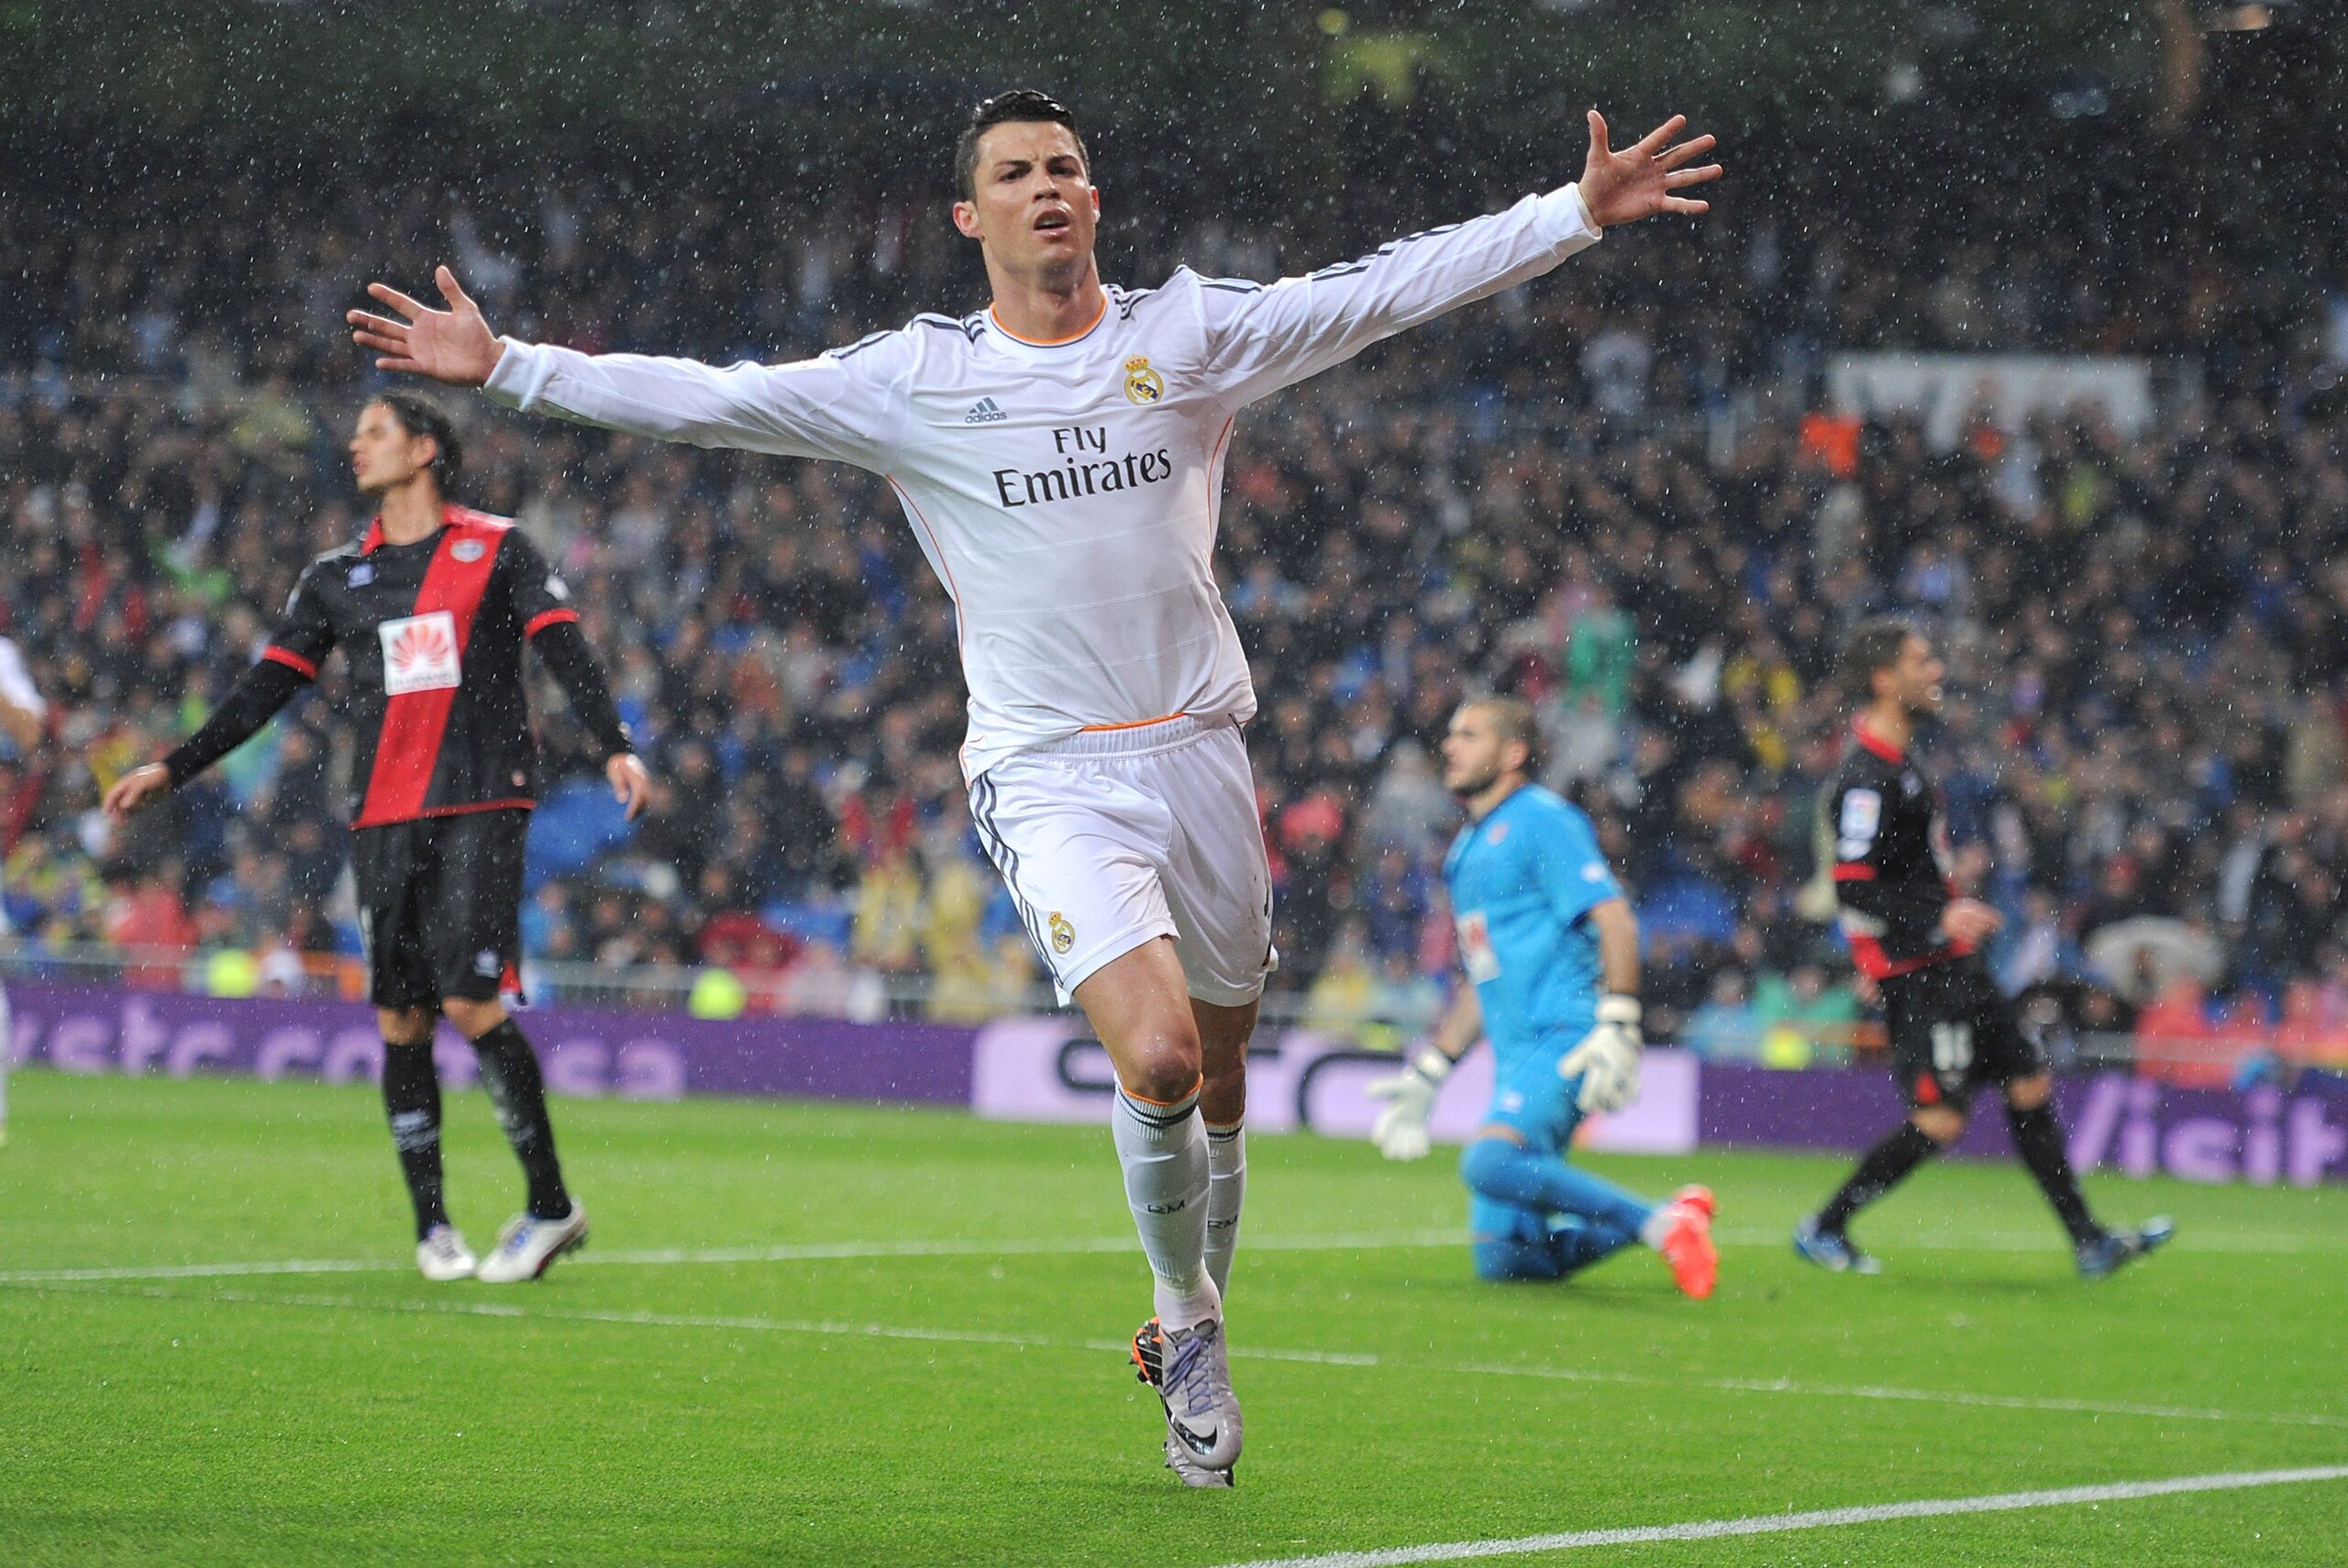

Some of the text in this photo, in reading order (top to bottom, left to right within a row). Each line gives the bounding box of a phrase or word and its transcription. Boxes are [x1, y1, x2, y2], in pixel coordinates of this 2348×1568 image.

[965, 411, 1007, 425] adidas
[1052, 426, 1107, 455] Fly
[991, 448, 1172, 508] Emirates
